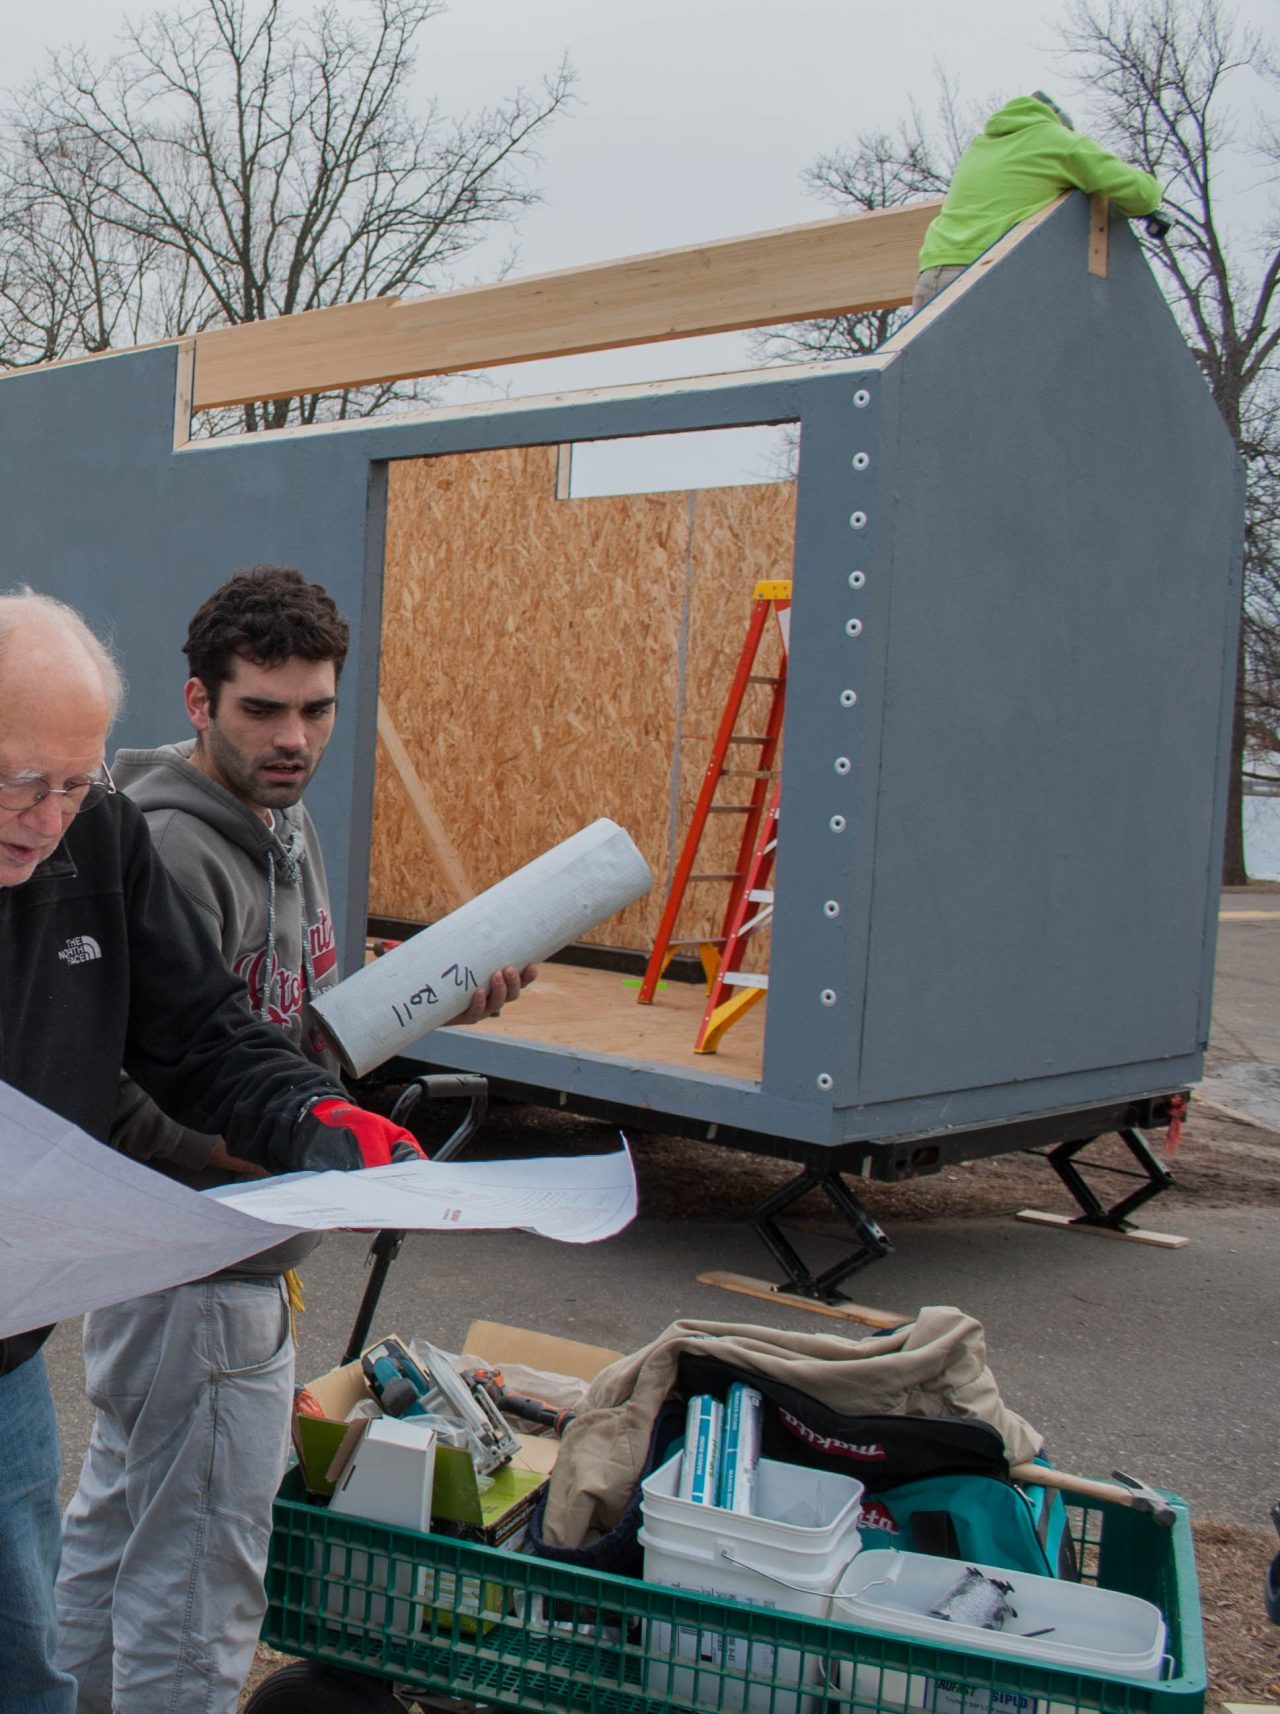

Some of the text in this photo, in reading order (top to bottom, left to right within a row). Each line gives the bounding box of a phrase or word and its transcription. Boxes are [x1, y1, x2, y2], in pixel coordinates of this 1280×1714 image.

[65, 936, 82, 948] THE
[58, 946, 85, 960] NORTH
[391, 983, 440, 1028] Roll
